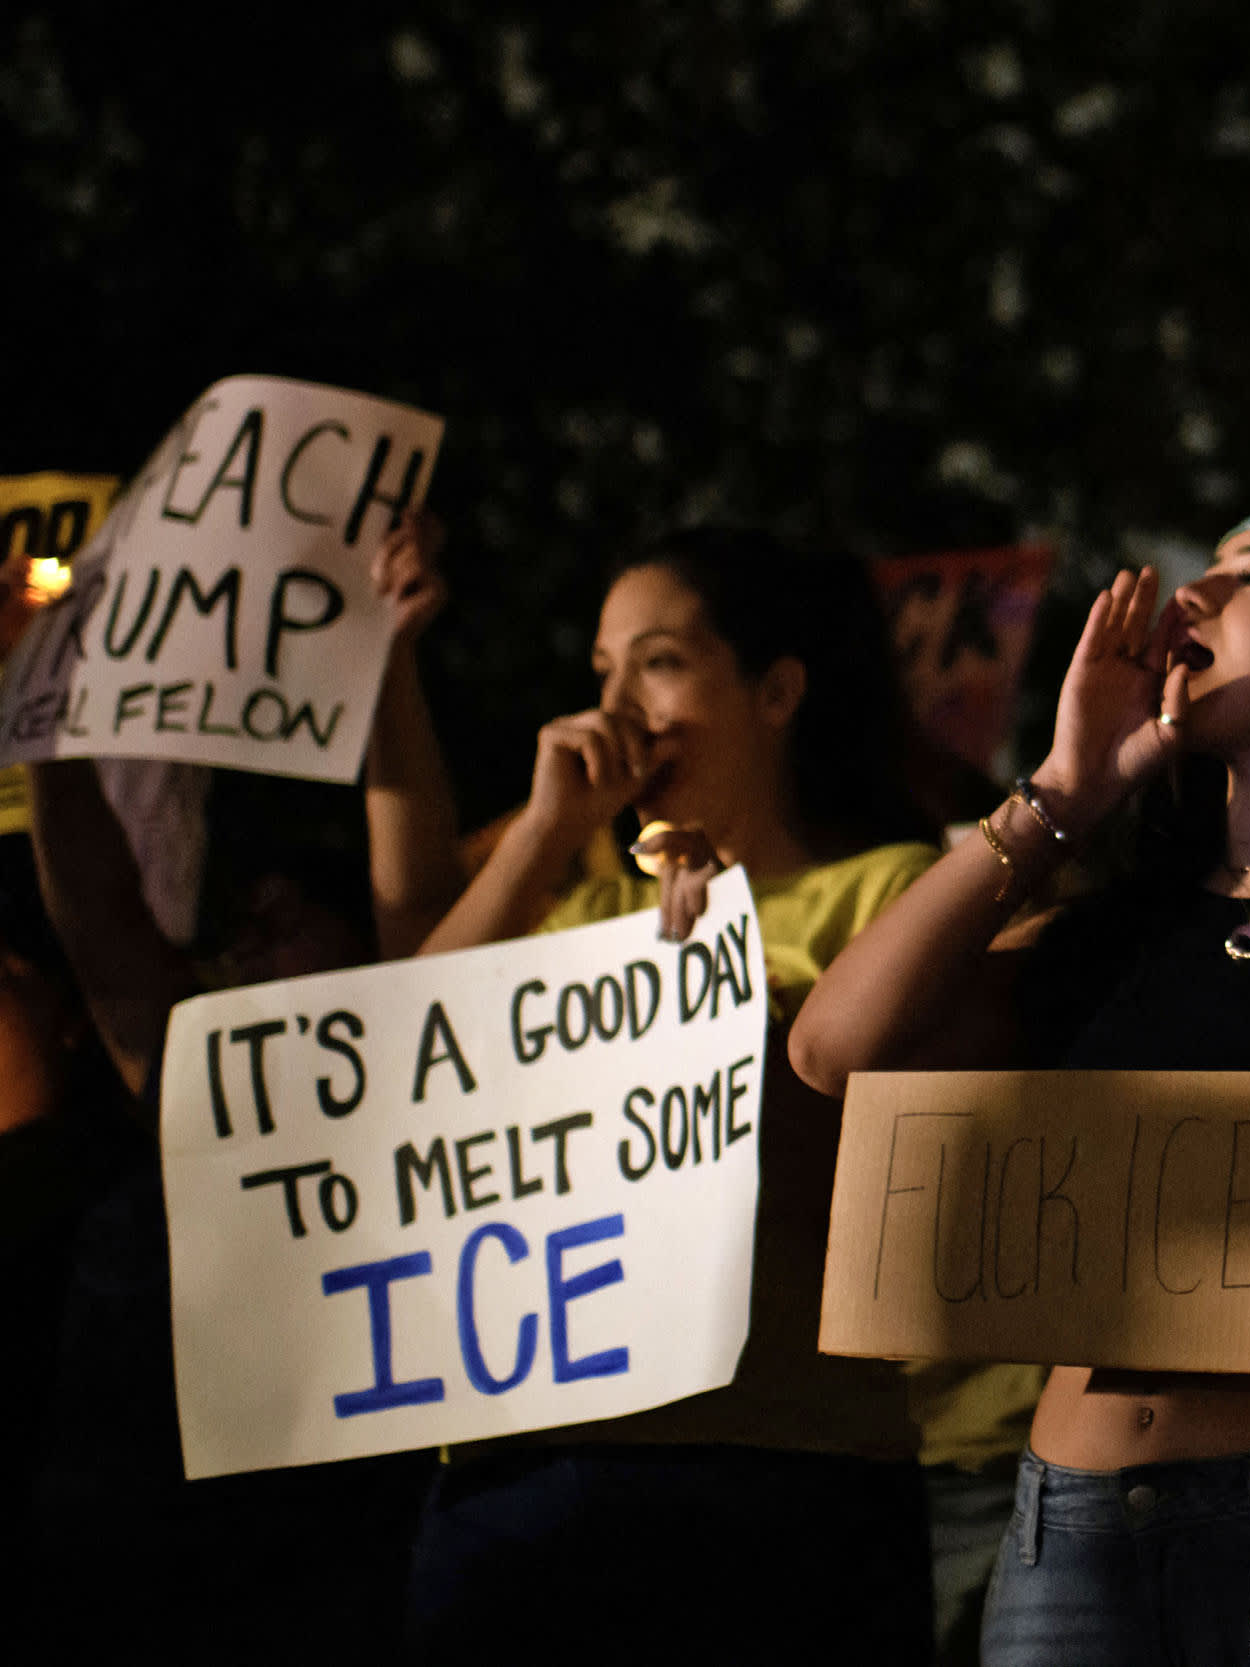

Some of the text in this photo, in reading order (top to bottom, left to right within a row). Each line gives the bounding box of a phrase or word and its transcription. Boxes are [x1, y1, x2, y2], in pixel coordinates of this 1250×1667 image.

[112, 680, 346, 750] FELON
[205, 913, 754, 1138] IT'S A GOOD DAY
[240, 1055, 755, 1238] TO MELT SOME
[873, 1112, 1082, 1303] FUCK
[321, 1212, 631, 1420] ICE
